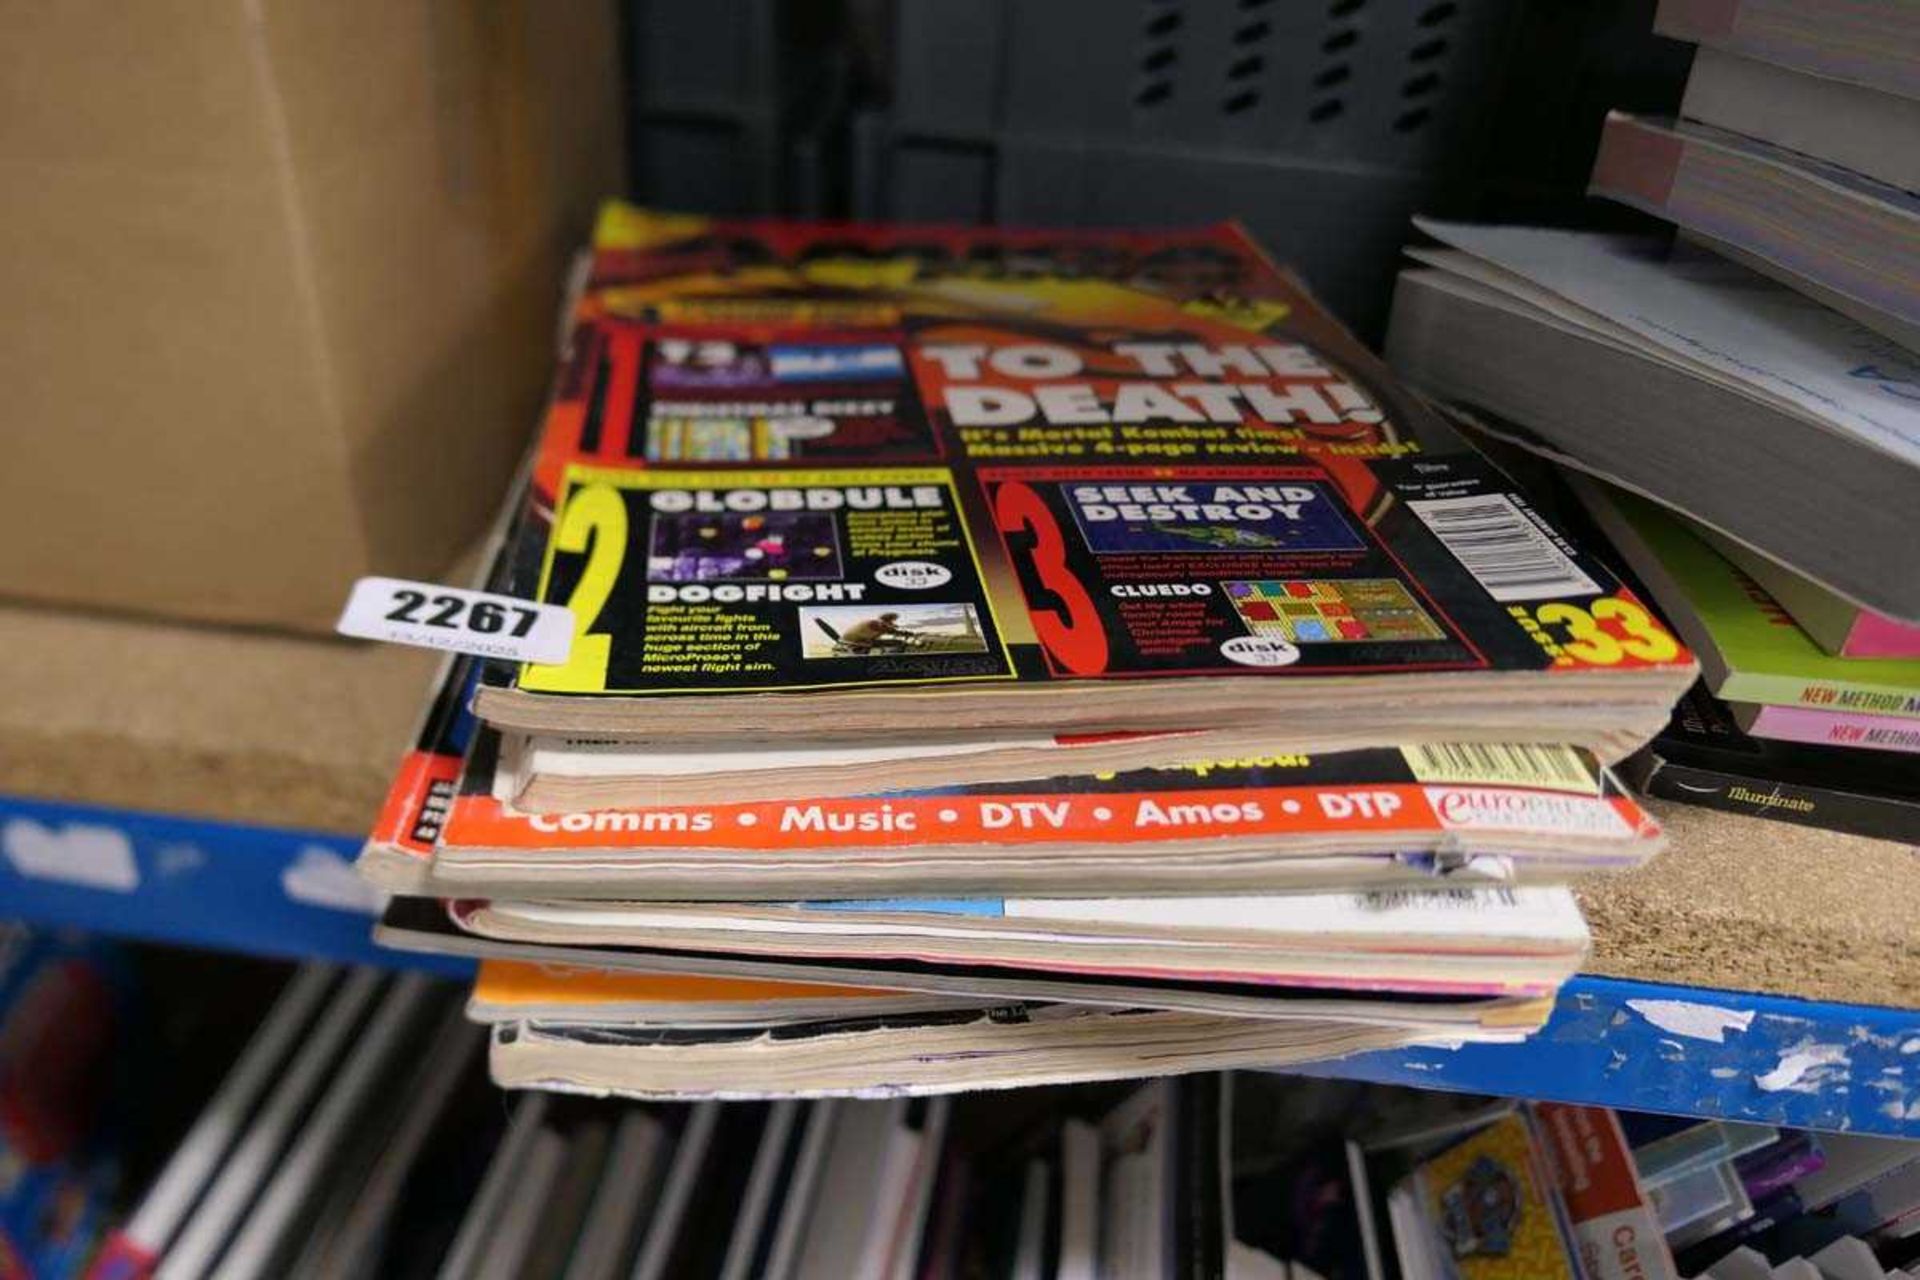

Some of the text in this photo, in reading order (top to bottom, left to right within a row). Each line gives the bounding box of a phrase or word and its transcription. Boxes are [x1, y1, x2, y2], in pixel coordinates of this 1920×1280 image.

[921, 343, 1085, 381] TO
[1115, 342, 1332, 378] THE
[943, 382, 1387, 427] DEATH!
[961, 428, 1008, 442] It's
[1018, 426, 1113, 441] Mortal
[1121, 426, 1228, 440] Kombat
[967, 440, 1422, 456] Massive 4-page review inside!
[650, 485, 943, 512] GLOBDULE
[1073, 486, 1316, 503] SEEK AND
[1081, 503, 1302, 521] DESTROY
[884, 566, 941, 578] disk
[996, 482, 1109, 674] 3
[648, 583, 866, 602] DOGFIGHT
[1110, 583, 1212, 597] CLUEDO
[384, 590, 540, 638] 2267
[646, 615, 712, 623] favourite
[647, 605, 723, 616] Fight your
[646, 623, 772, 632] with aircraft from
[1537, 597, 1679, 666] 33
[644, 631, 781, 642] across time in this
[643, 641, 762, 653] huge section of
[1228, 640, 1288, 653] disk
[642, 652, 743, 662] MicroProse's
[641, 661, 776, 673] newest flight sim.
[1801, 686, 1838, 704] NEW
[1840, 689, 1905, 711] METHOD
[1830, 724, 1867, 742] NEW
[1728, 785, 1816, 813] Illuminate
[528, 810, 713, 833] Comms
[780, 804, 918, 832] Music
[980, 801, 1070, 829] DTV
[1136, 799, 1265, 827] Amos
[1317, 791, 1403, 819] DTP
